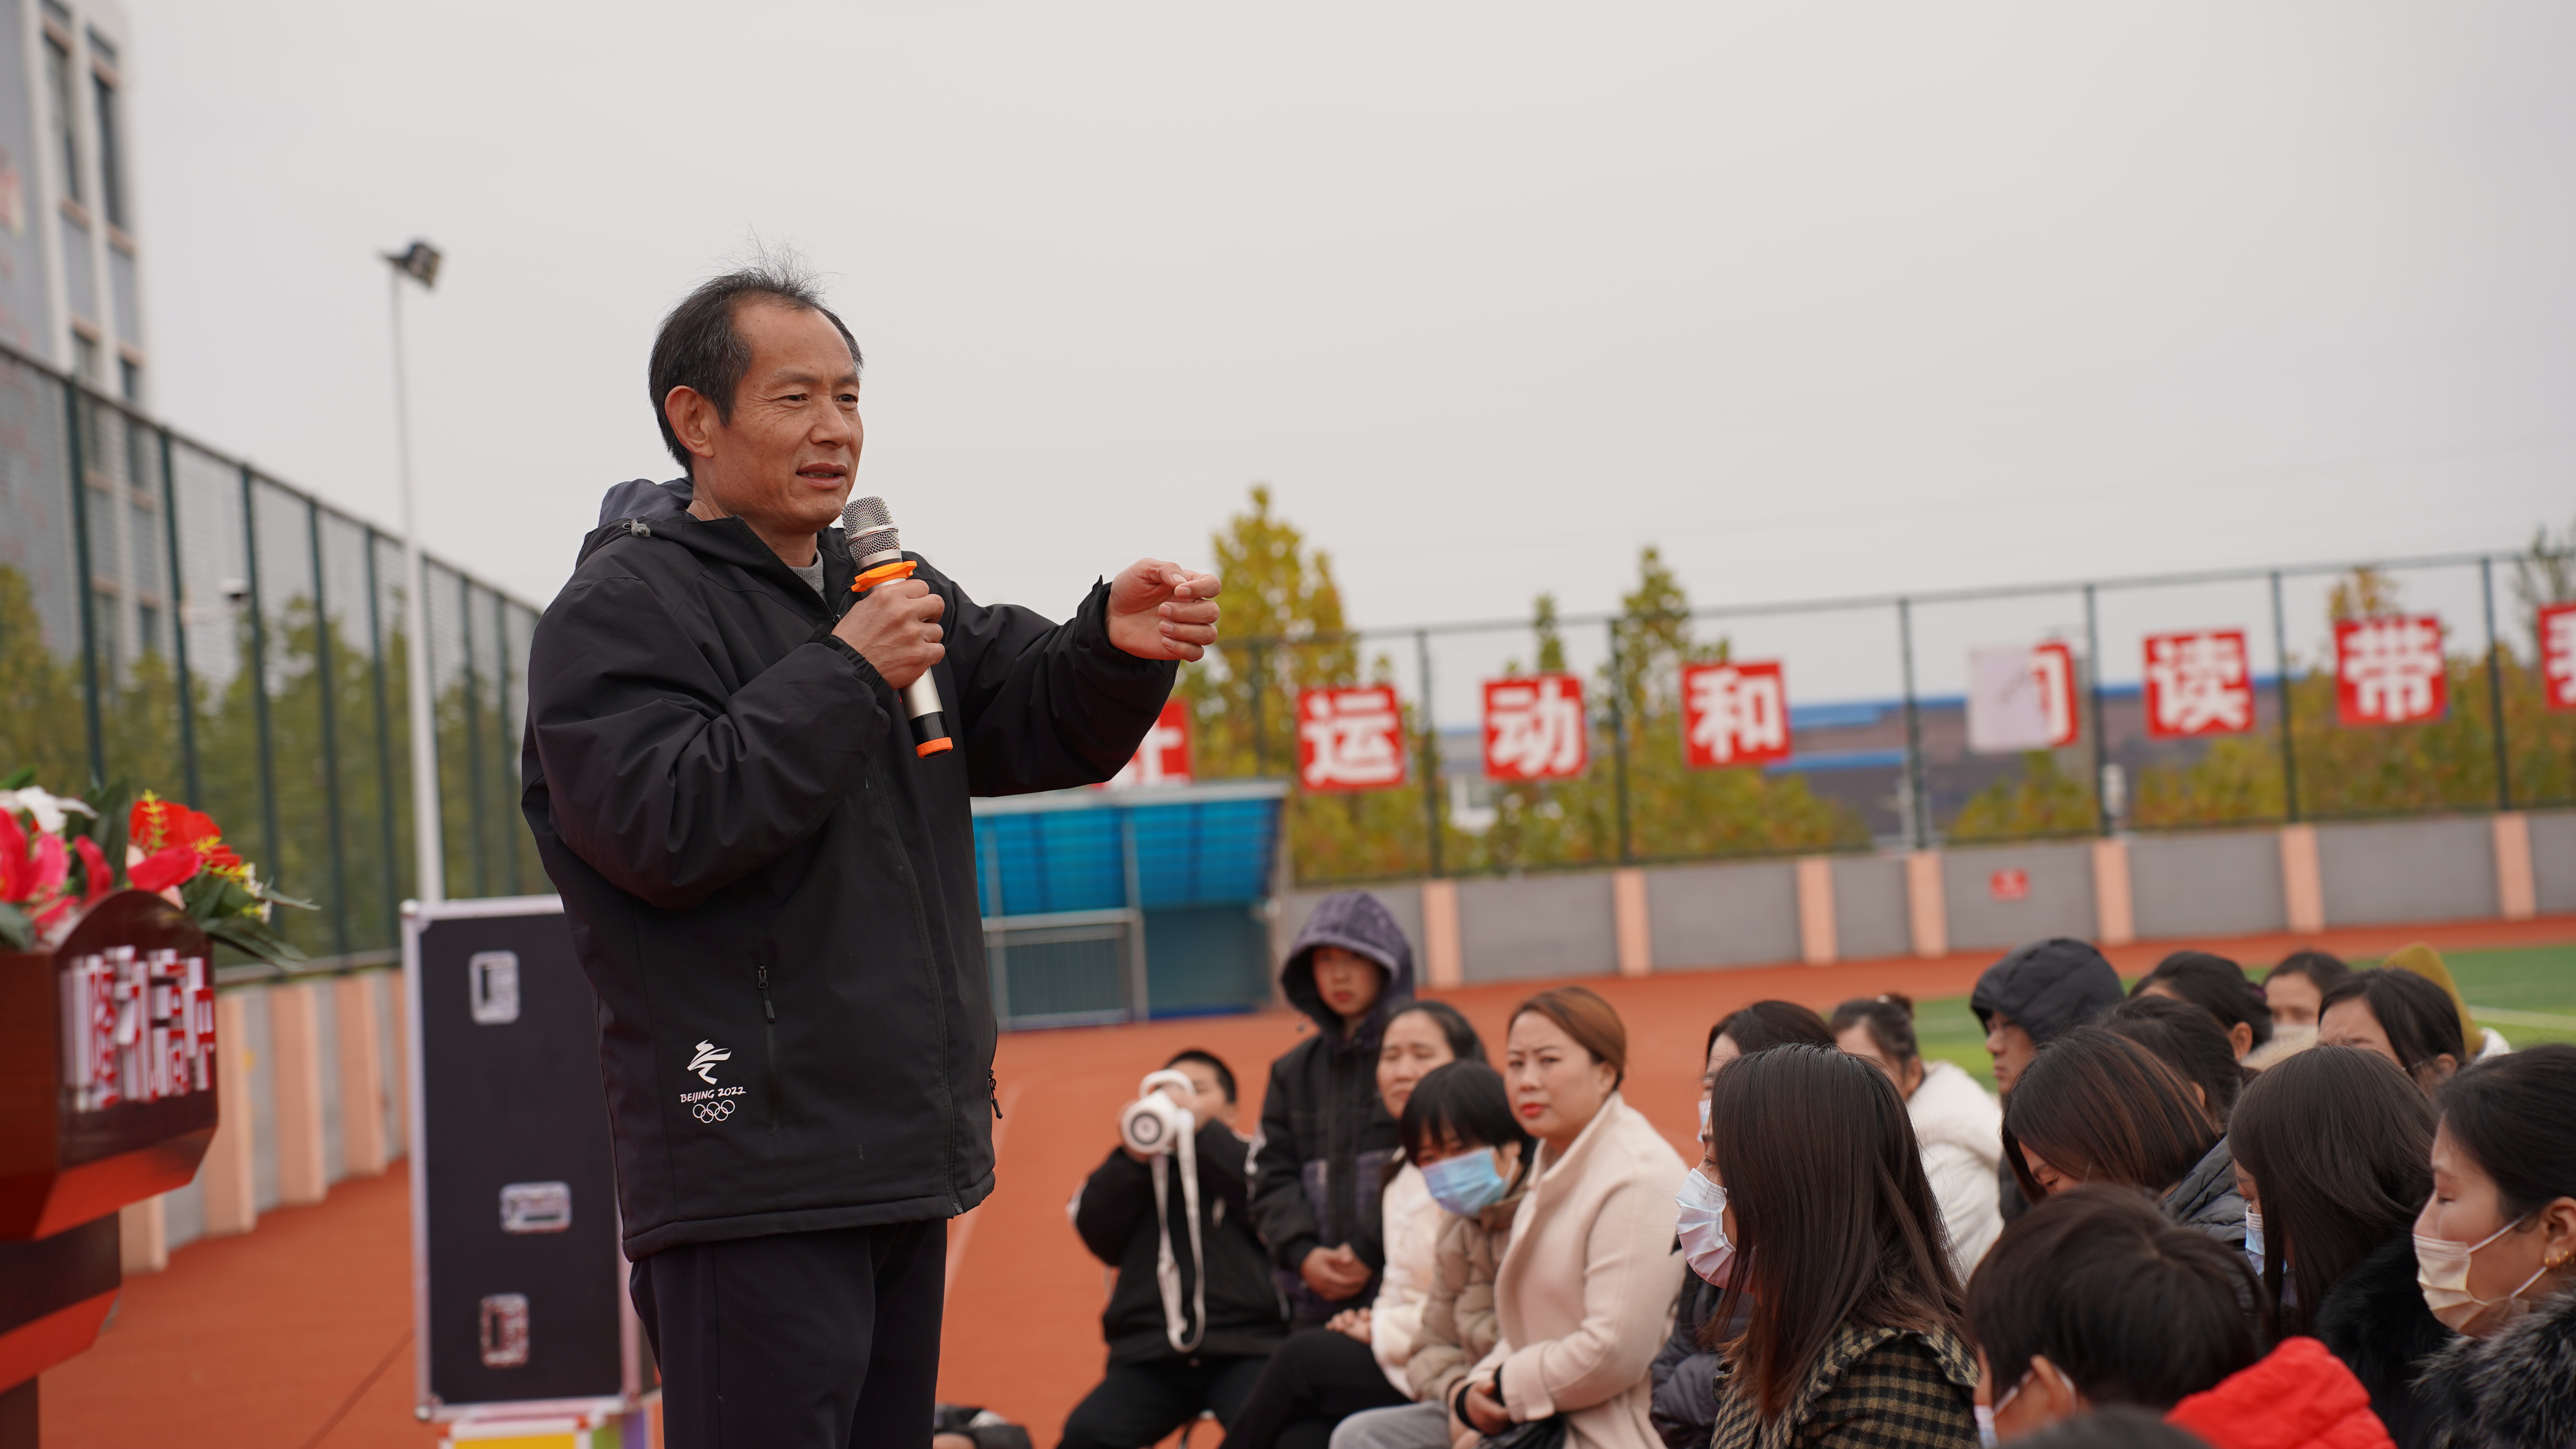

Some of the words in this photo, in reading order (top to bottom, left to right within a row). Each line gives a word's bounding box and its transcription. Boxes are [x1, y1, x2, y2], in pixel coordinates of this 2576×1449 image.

[1303, 691, 1399, 785] 运
[1489, 680, 1583, 775] 动
[1691, 668, 1786, 761] 和
[2151, 636, 2250, 730] 读
[2343, 621, 2439, 721] 带
[680, 1089, 714, 1103] BEIJING
[718, 1086, 747, 1097] 2022
